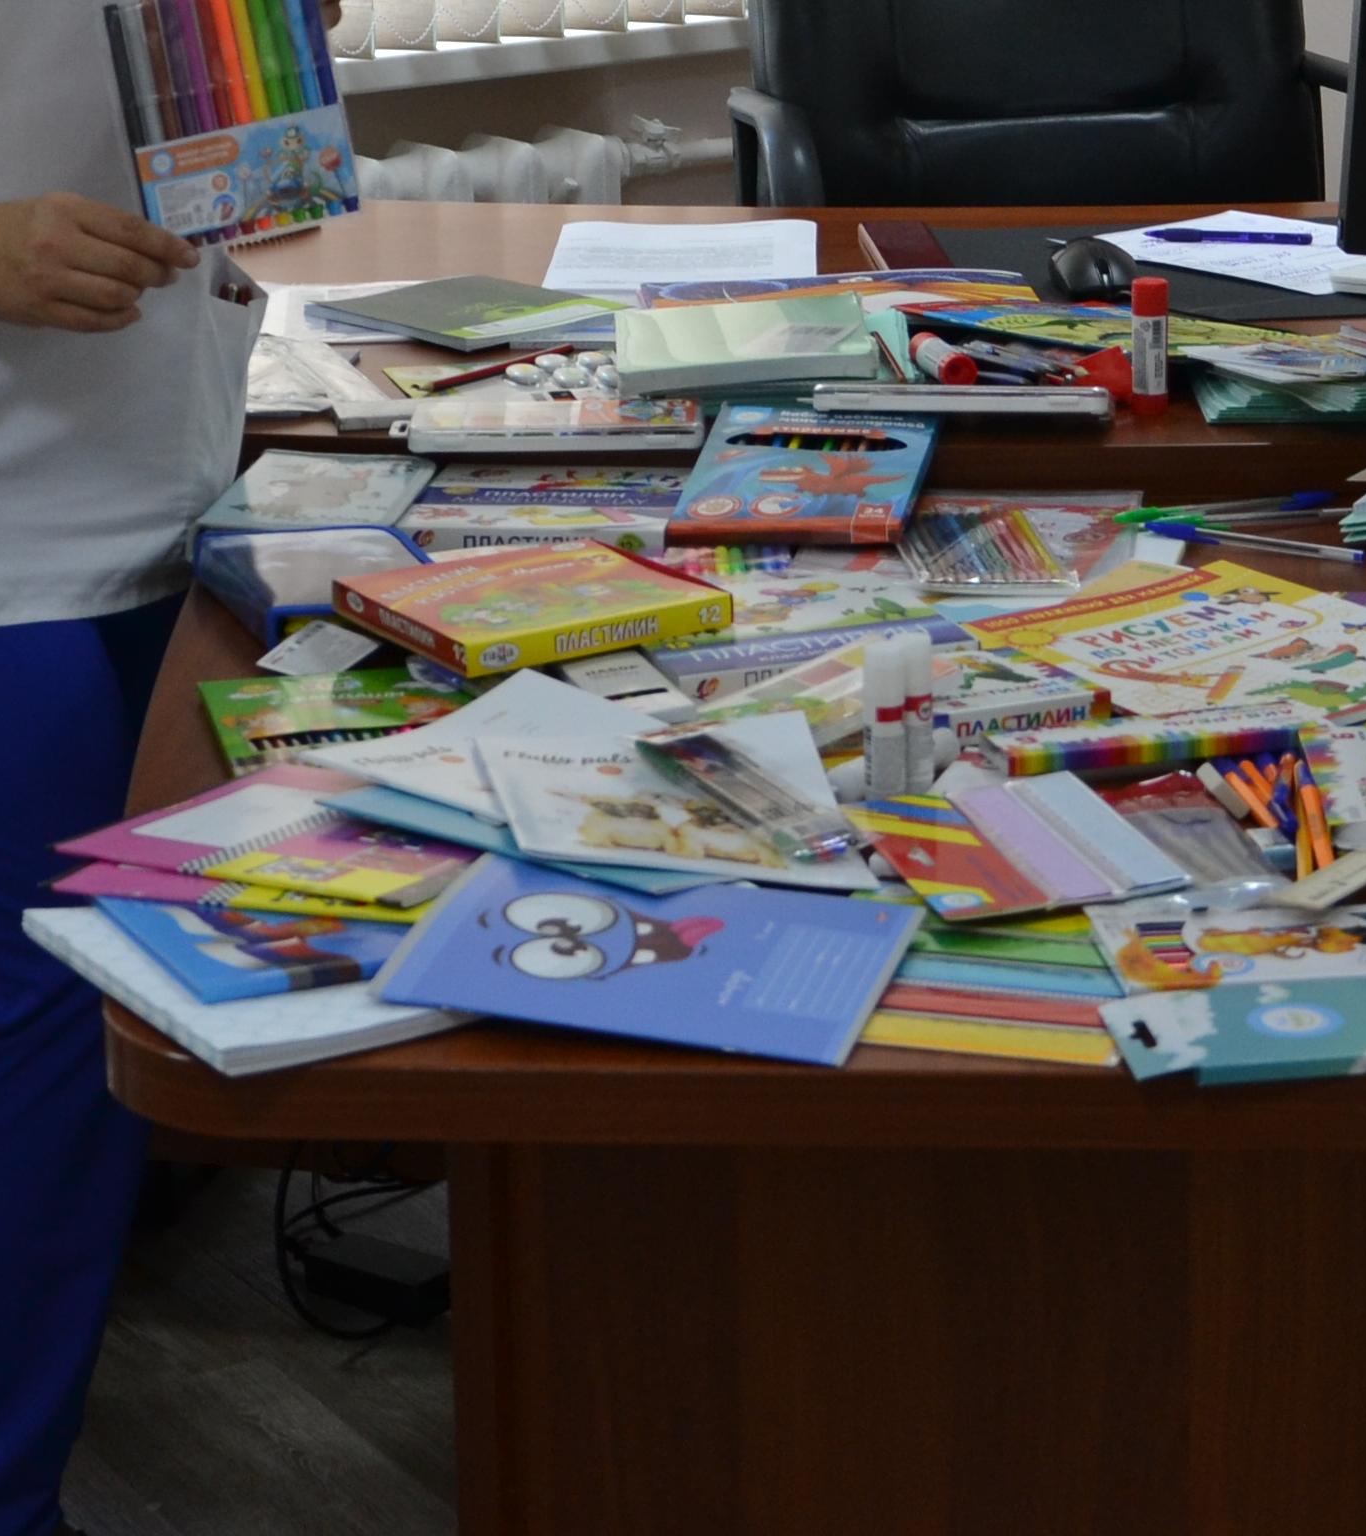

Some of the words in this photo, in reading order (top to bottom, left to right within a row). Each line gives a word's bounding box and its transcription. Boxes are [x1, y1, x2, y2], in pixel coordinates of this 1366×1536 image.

[554, 616, 659, 654] ПЛАСТИЛИН
[698, 604, 722, 624] 12
[1075, 605, 1231, 648] РИСУЕМ
[956, 706, 1085, 738] ПЛАСТИЛИН
[580, 750, 633, 765] pals
